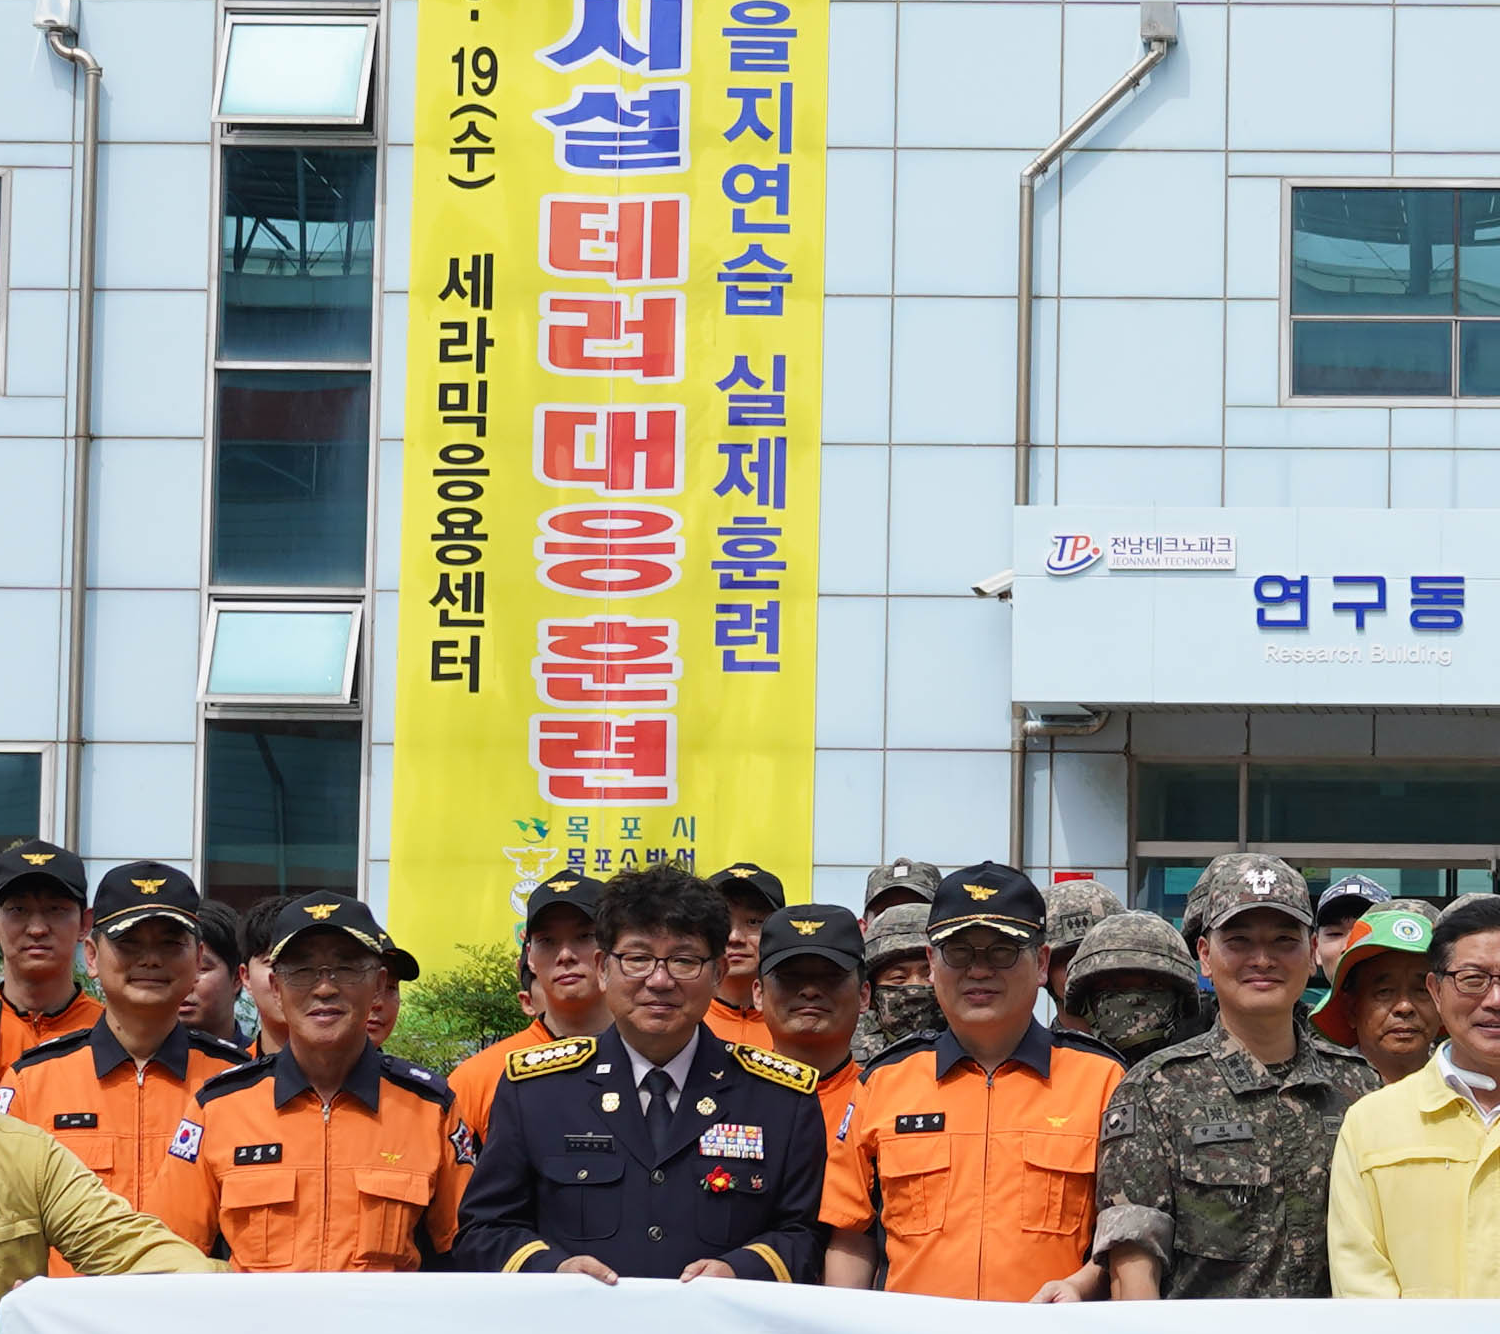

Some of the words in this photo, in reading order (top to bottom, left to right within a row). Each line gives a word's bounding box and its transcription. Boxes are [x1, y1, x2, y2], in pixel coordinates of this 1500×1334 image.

[716, 0, 798, 317] 을지연습
[547, 199, 681, 378] 테러
[429, 253, 496, 693] 세라믹응용센터
[542, 409, 677, 593] 대응
[711, 354, 789, 673] 실제훈련
[1111, 536, 1233, 555] 전남테크노파크
[1112, 556, 1161, 567] JEONNAM
[1164, 556, 1231, 567] TECHNOPARK
[1253, 574, 1466, 632] 연구동
[1264, 644, 1363, 664] Research
[1370, 644, 1453, 667] Building
[538, 620, 674, 801] 훈련
[566, 816, 696, 843] 목포시
